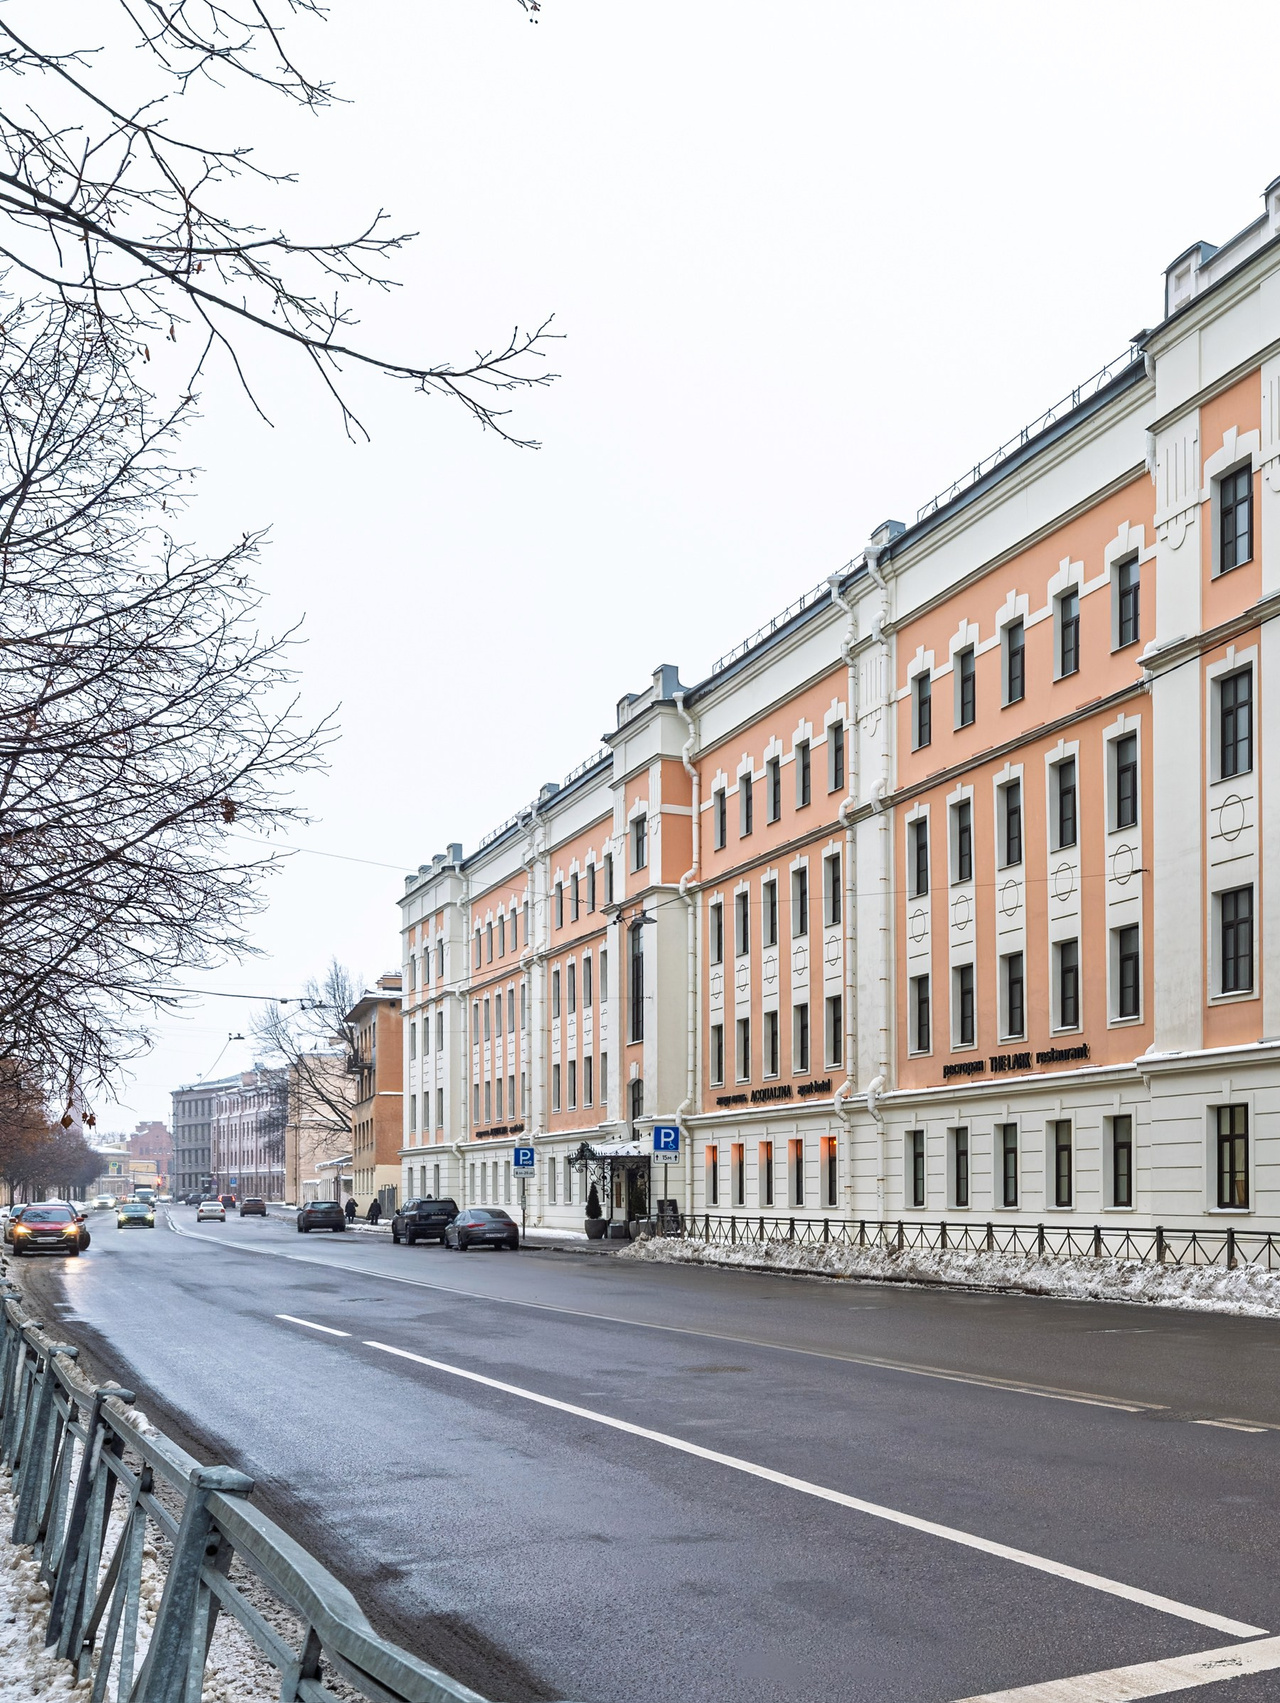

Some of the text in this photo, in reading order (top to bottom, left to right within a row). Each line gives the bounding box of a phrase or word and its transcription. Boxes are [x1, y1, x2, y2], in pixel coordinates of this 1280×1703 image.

[989, 1056, 1007, 1073] THE
[1036, 1043, 1090, 1064] restaurant
[660, 1128, 675, 1148] P
[519, 1149, 531, 1165] P
